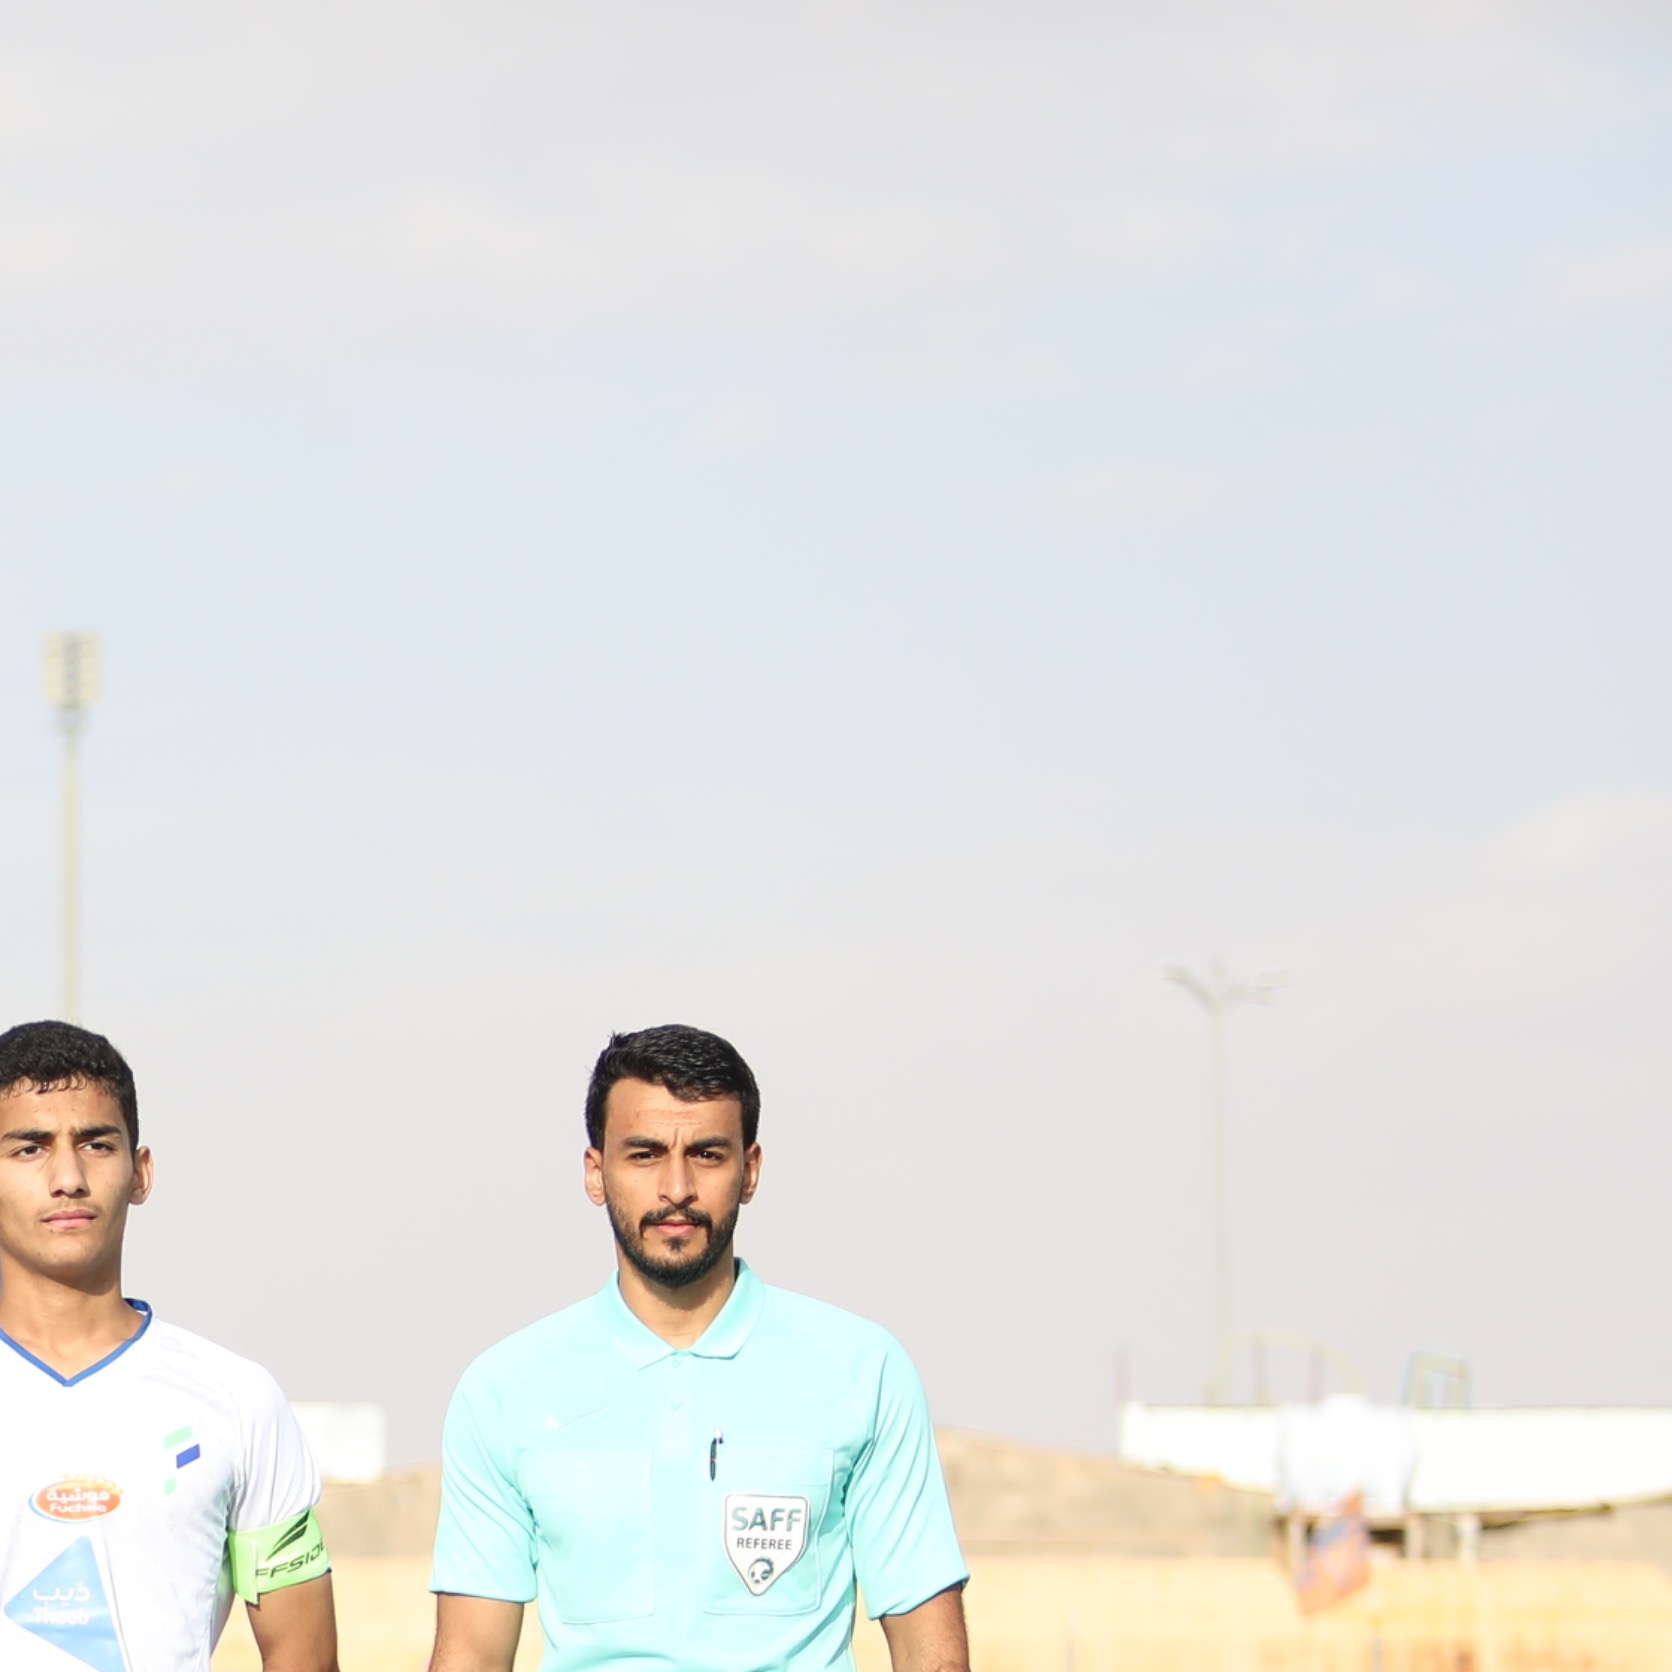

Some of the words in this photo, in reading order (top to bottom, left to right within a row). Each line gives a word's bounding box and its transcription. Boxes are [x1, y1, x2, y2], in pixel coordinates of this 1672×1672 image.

[731, 1506, 802, 1532] SAFF
[737, 1537, 792, 1551] REFEREE
[255, 1536, 324, 1578] FFSID
[32, 1581, 90, 1606] ذيب
